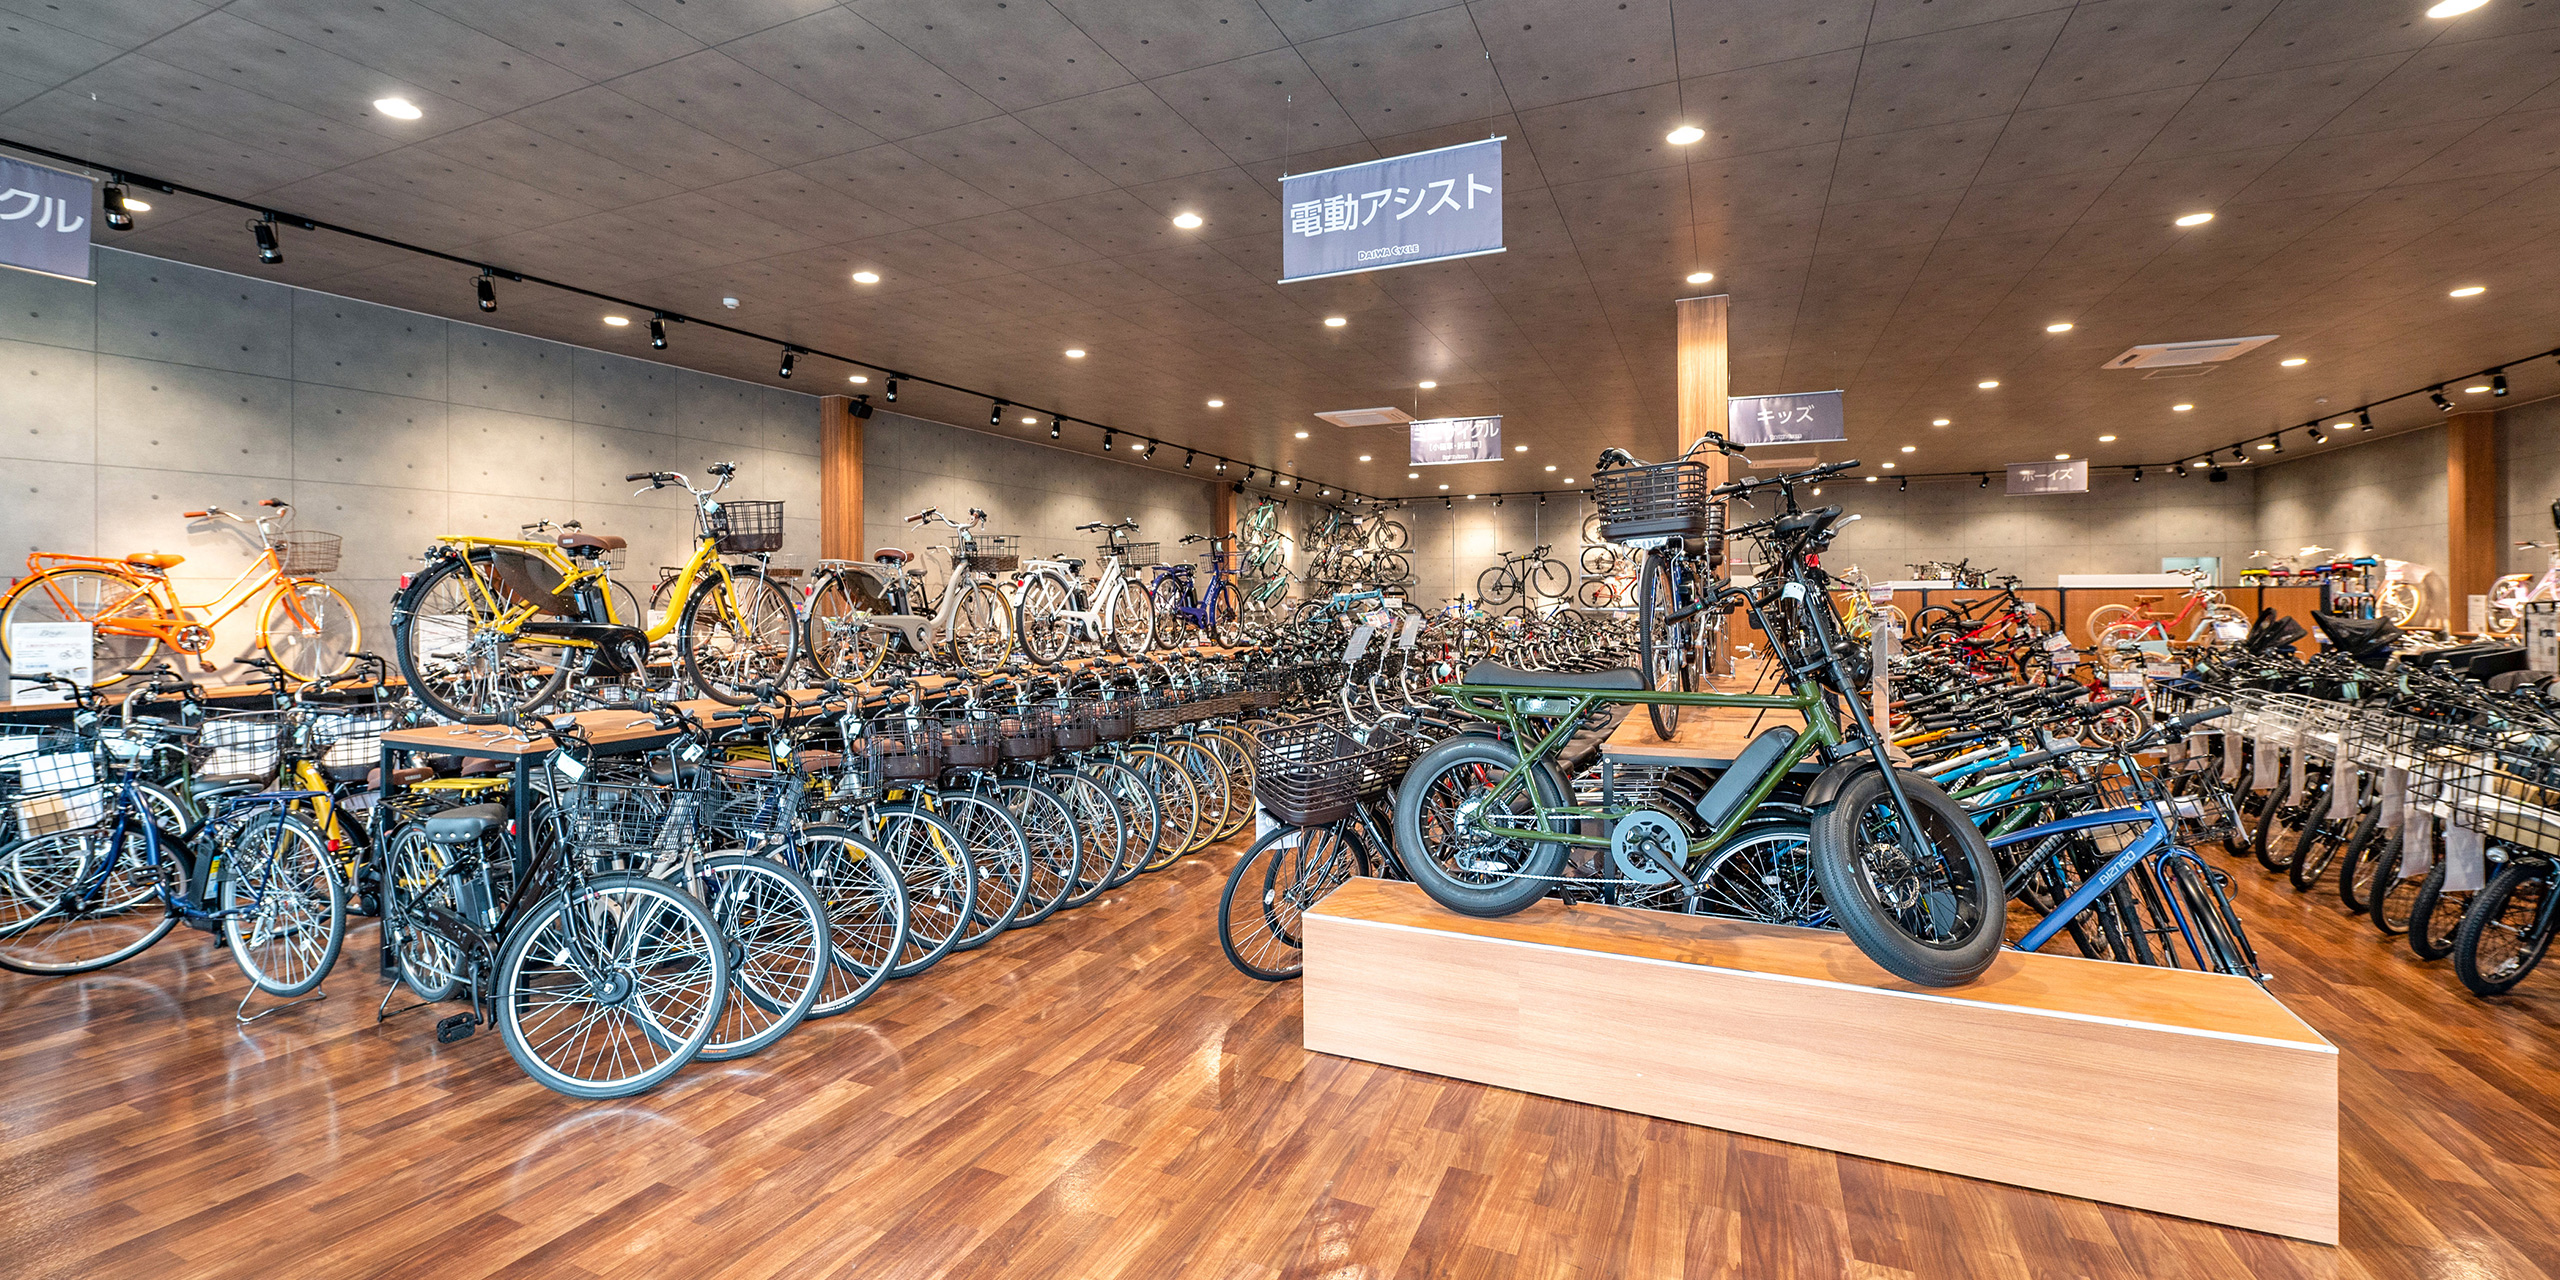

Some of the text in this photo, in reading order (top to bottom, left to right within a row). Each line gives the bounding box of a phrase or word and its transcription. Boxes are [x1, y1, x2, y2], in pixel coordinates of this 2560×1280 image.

[1290, 173, 1493, 238] 電動アシスト
[1358, 247, 1391, 261] DAIWA
[1757, 404, 1815, 425] キッズ
[2002, 805, 2032, 831] Panasonic
